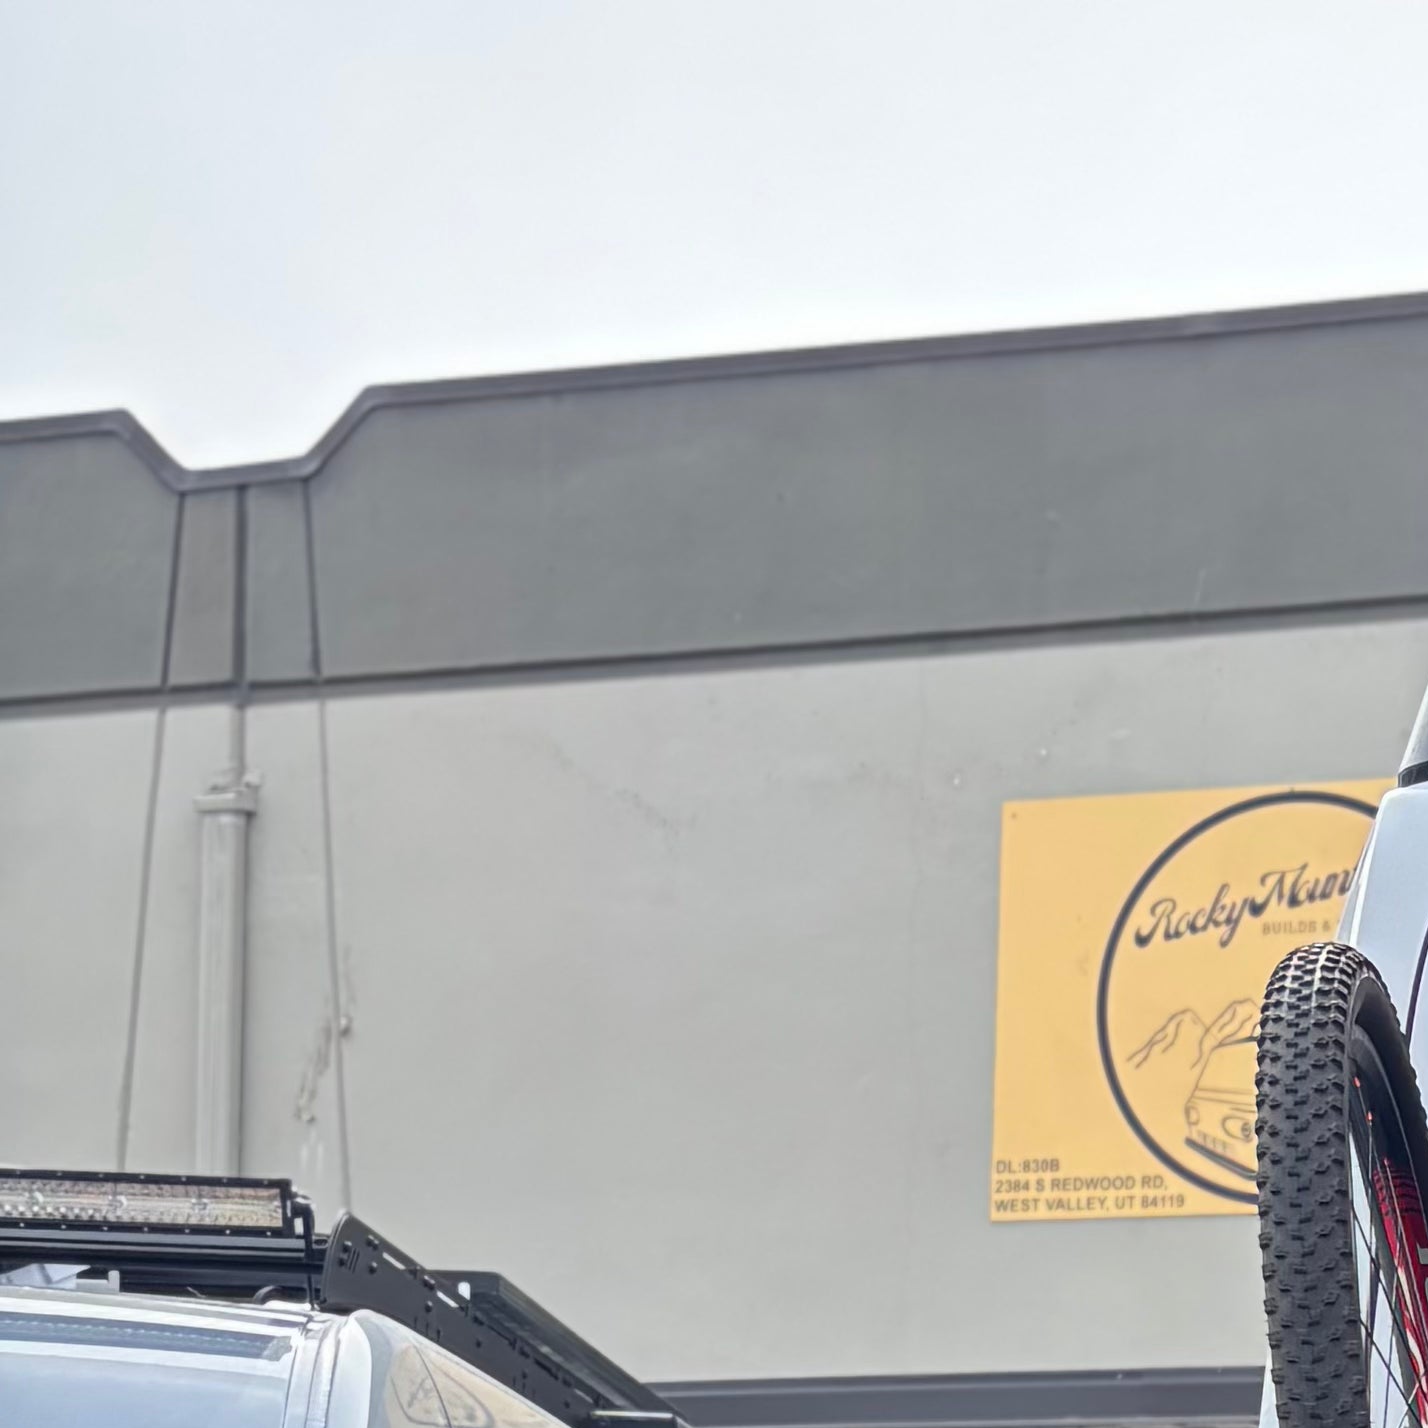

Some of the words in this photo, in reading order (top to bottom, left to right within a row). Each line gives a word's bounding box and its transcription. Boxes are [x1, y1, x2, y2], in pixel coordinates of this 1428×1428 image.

[1135, 883, 1255, 948] Rocky
[995, 1179, 1031, 1194] 2384
[1035, 1178, 1046, 1193] S
[1051, 1175, 1137, 1192] REDWOOD
[994, 1198, 1040, 1213] WEST
[1115, 1195, 1136, 1211] UT
[1140, 1193, 1186, 1209] 84119
